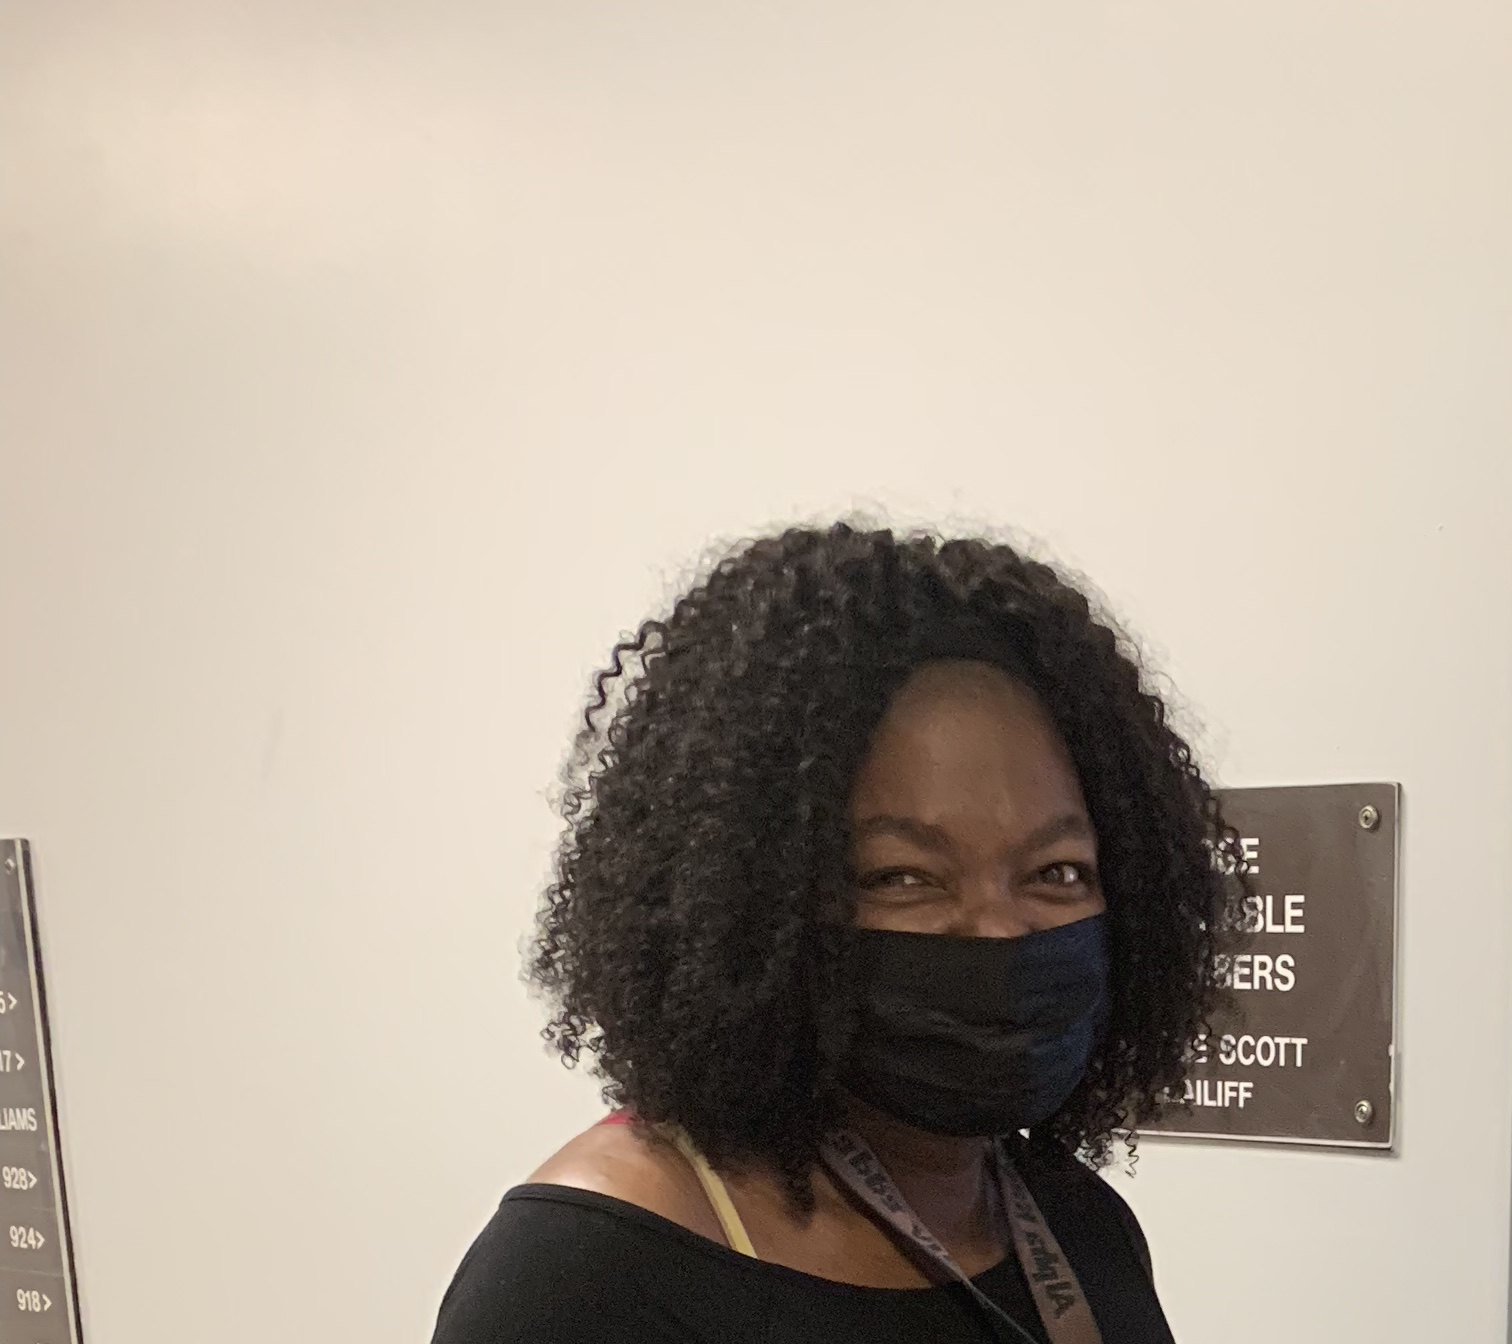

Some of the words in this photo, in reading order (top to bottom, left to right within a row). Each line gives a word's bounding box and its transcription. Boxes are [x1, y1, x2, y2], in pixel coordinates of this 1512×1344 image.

[1241, 894, 1305, 934] BLE
[1213, 953, 1296, 992] BERS
[1219, 1033, 1309, 1068] SCOTT
[1163, 1078, 1254, 1108] AILIFF
[2, 1166, 28, 1190] 928
[9, 1226, 37, 1249] 924
[16, 1289, 42, 1313] 918
